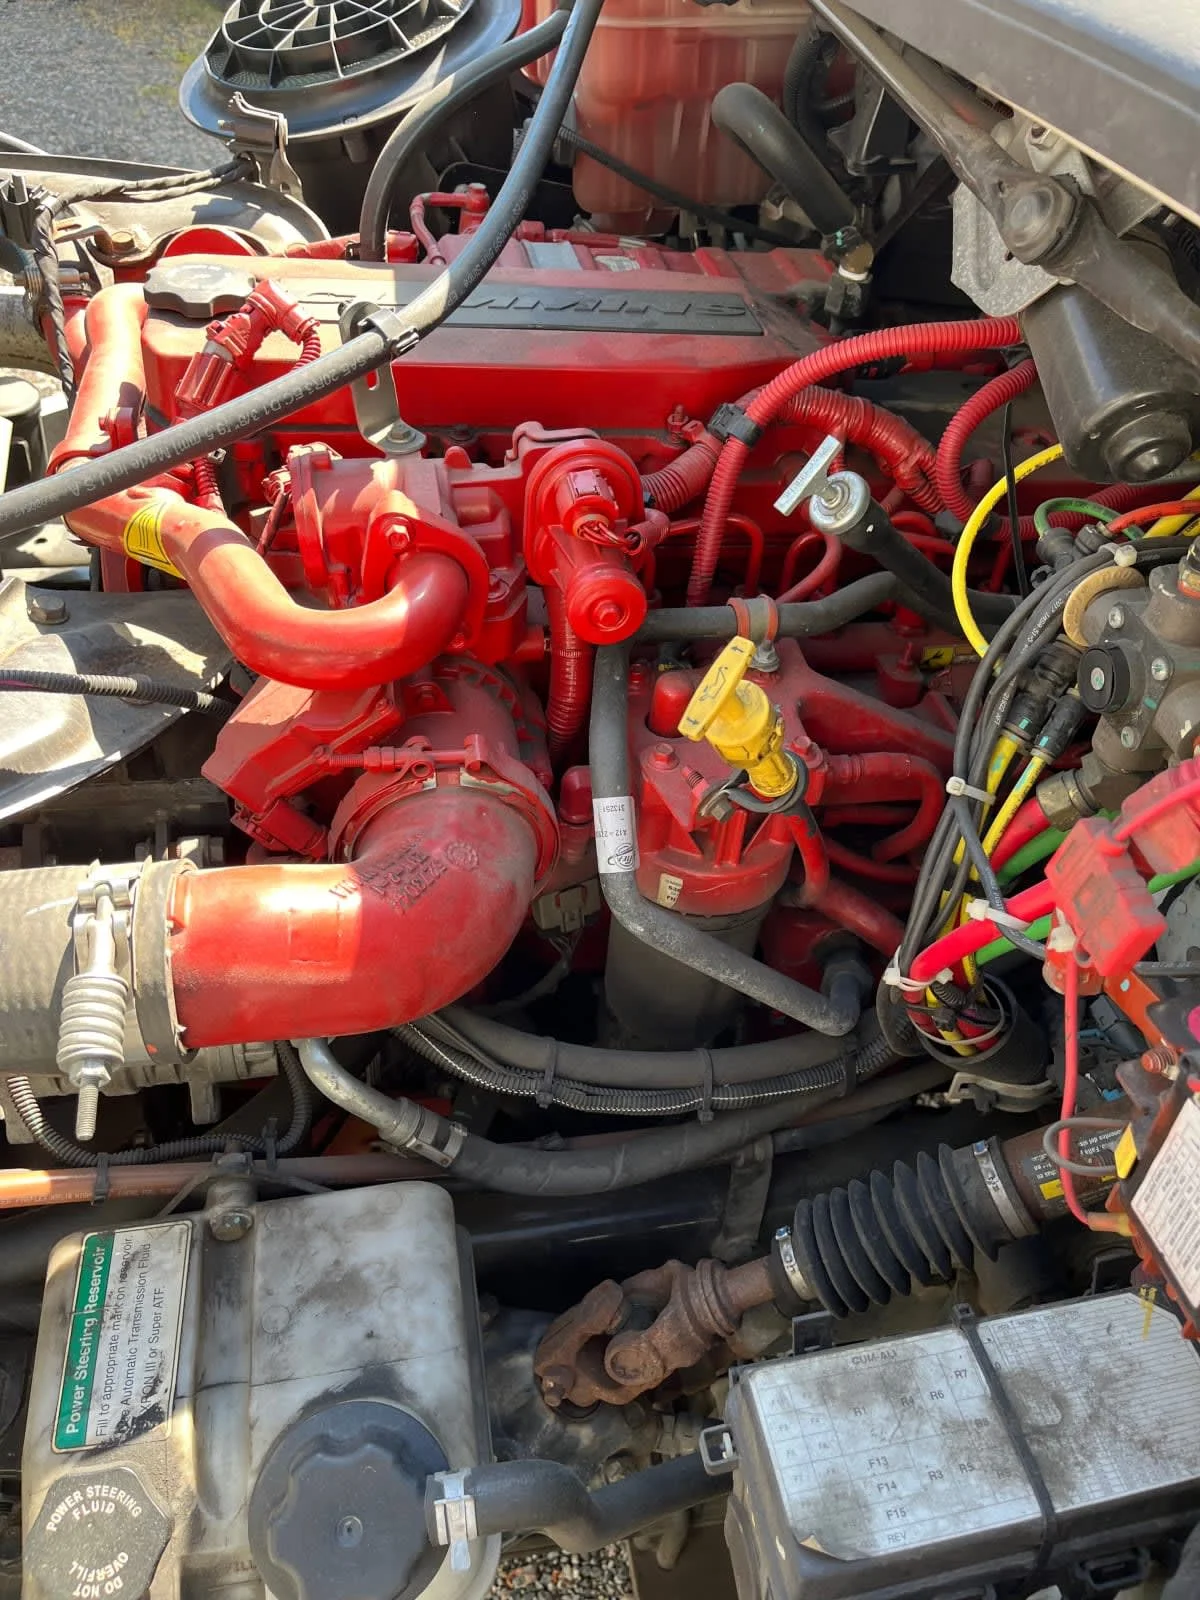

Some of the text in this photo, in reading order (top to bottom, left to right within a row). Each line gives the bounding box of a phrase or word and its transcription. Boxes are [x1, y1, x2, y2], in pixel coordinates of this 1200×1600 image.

[129, 445, 172, 471] Made
[138, 1242, 151, 1268] Fluid
[116, 1286, 126, 1300] on
[109, 1304, 124, 1331] mark
[127, 1270, 148, 1343] Transmission
[147, 1310, 163, 1344] Super
[65, 1245, 106, 1435] Power Steering Reservoir
[148, 1345, 158, 1358] or
[101, 1333, 121, 1399] appropriate
[119, 1347, 138, 1405] Automatic
[954, 1369, 968, 1380] R7
[929, 1388, 944, 1401] R6
[98, 1402, 110, 1416] to
[95, 1418, 109, 1436] Fill
[867, 1454, 889, 1470] F13
[876, 1479, 897, 1494] F14
[928, 1468, 944, 1481] R3
[958, 1461, 974, 1473] R5
[46, 1484, 142, 1532] POWER STEERING
[71, 1502, 115, 1521] FLUID
[885, 1506, 907, 1521] F15
[886, 1530, 907, 1544] REV
[67, 1551, 128, 1582] OVERFILL
[71, 1575, 123, 1597] DO NOT
